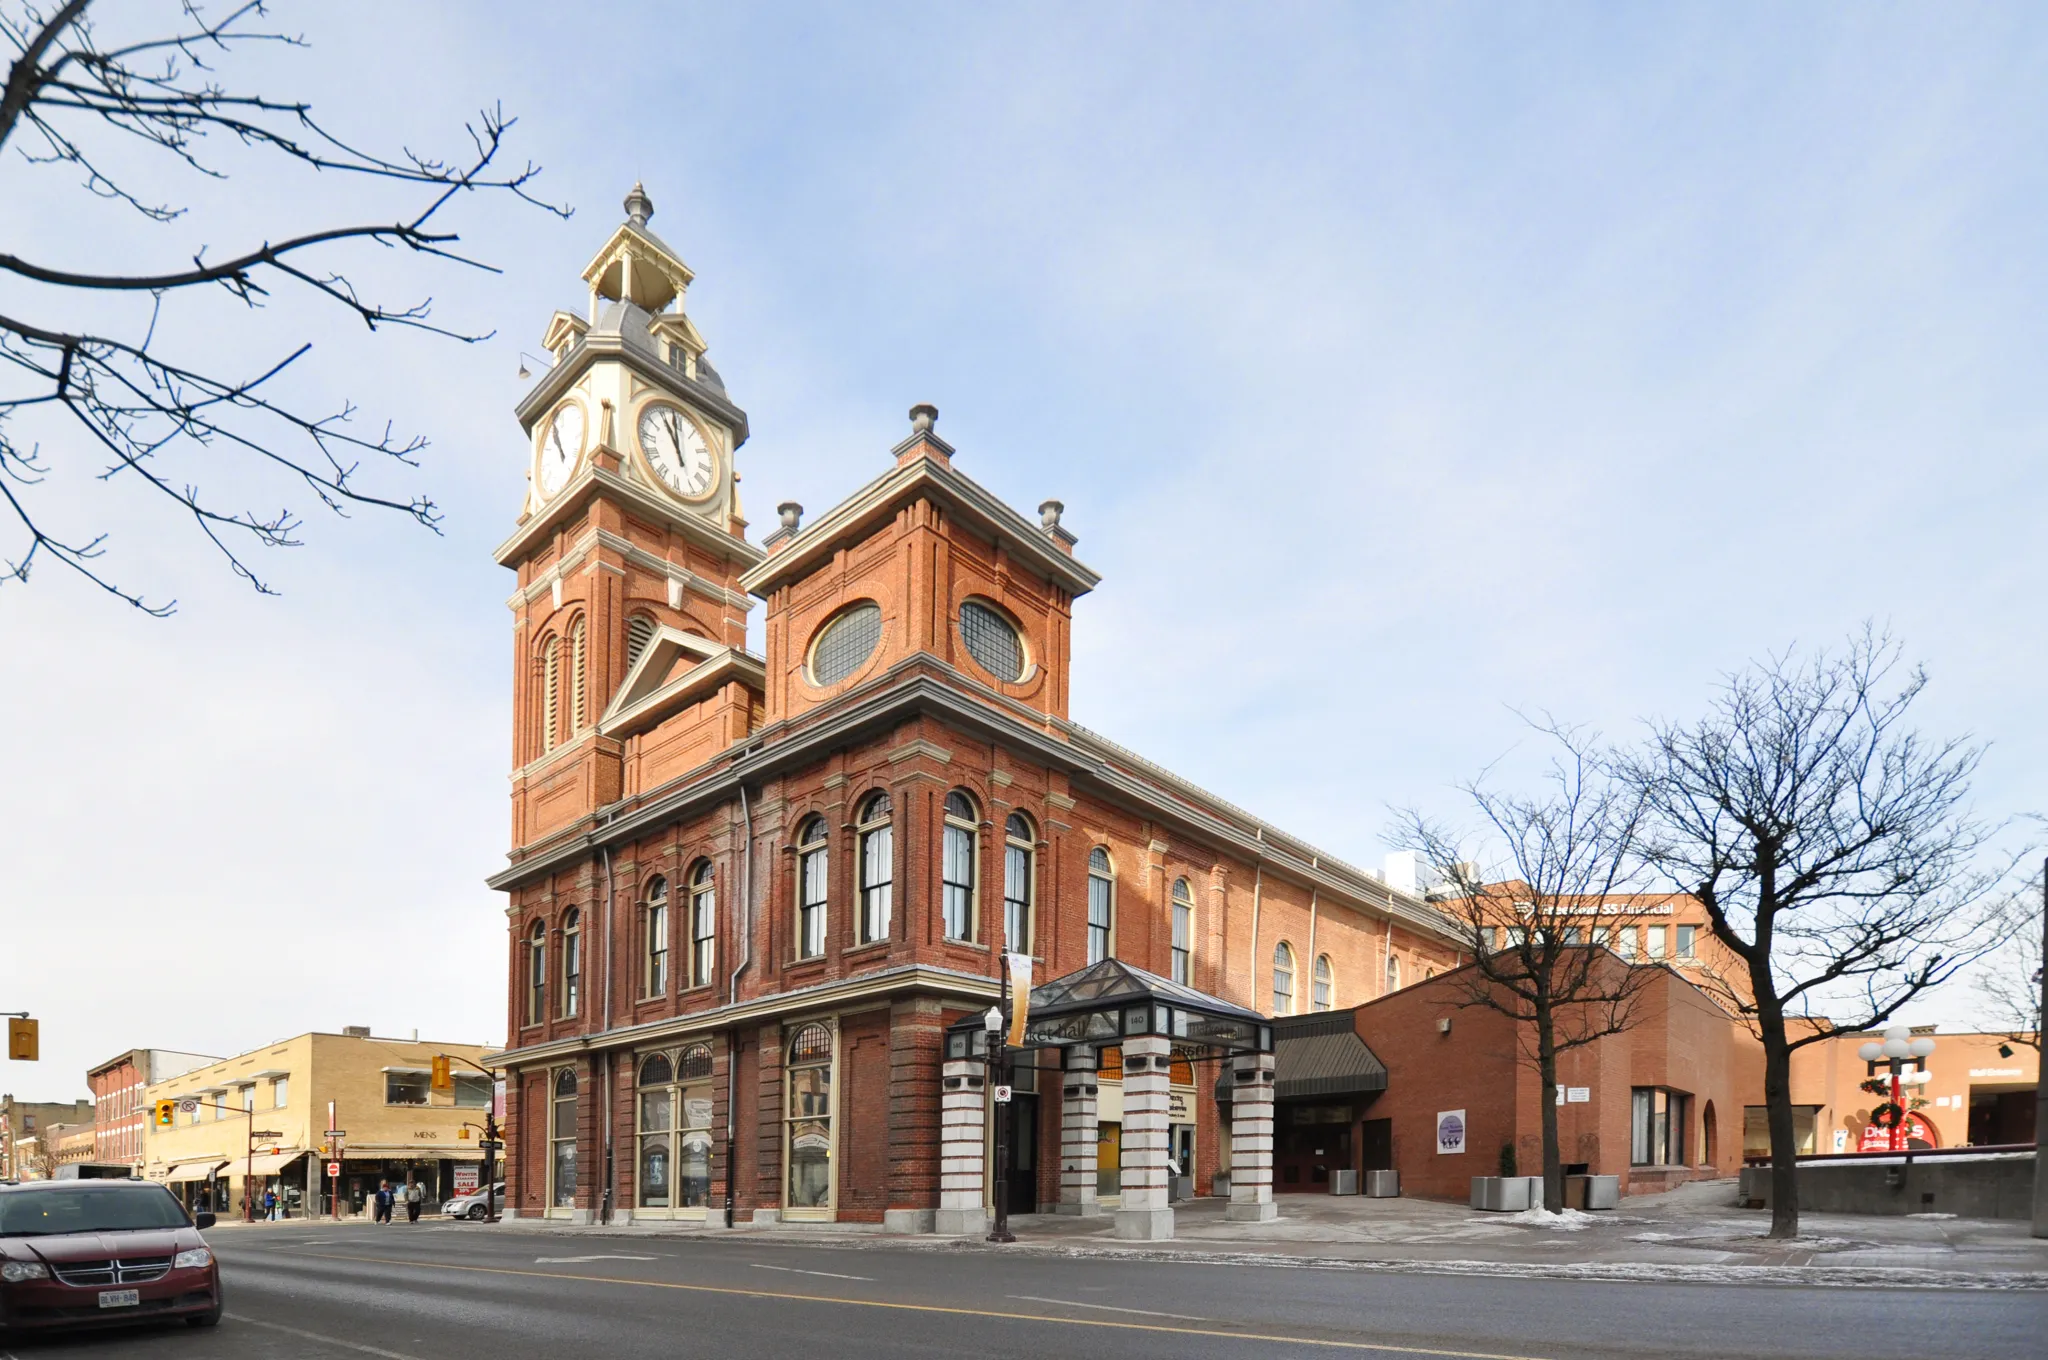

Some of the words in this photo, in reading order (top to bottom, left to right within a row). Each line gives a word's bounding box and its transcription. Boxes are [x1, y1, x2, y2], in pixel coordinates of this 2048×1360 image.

[1602, 903, 1619, 915] 55
[1621, 902, 1674, 915] Financial
[1130, 1016, 1144, 1025] 140
[414, 1131, 437, 1139] MENS
